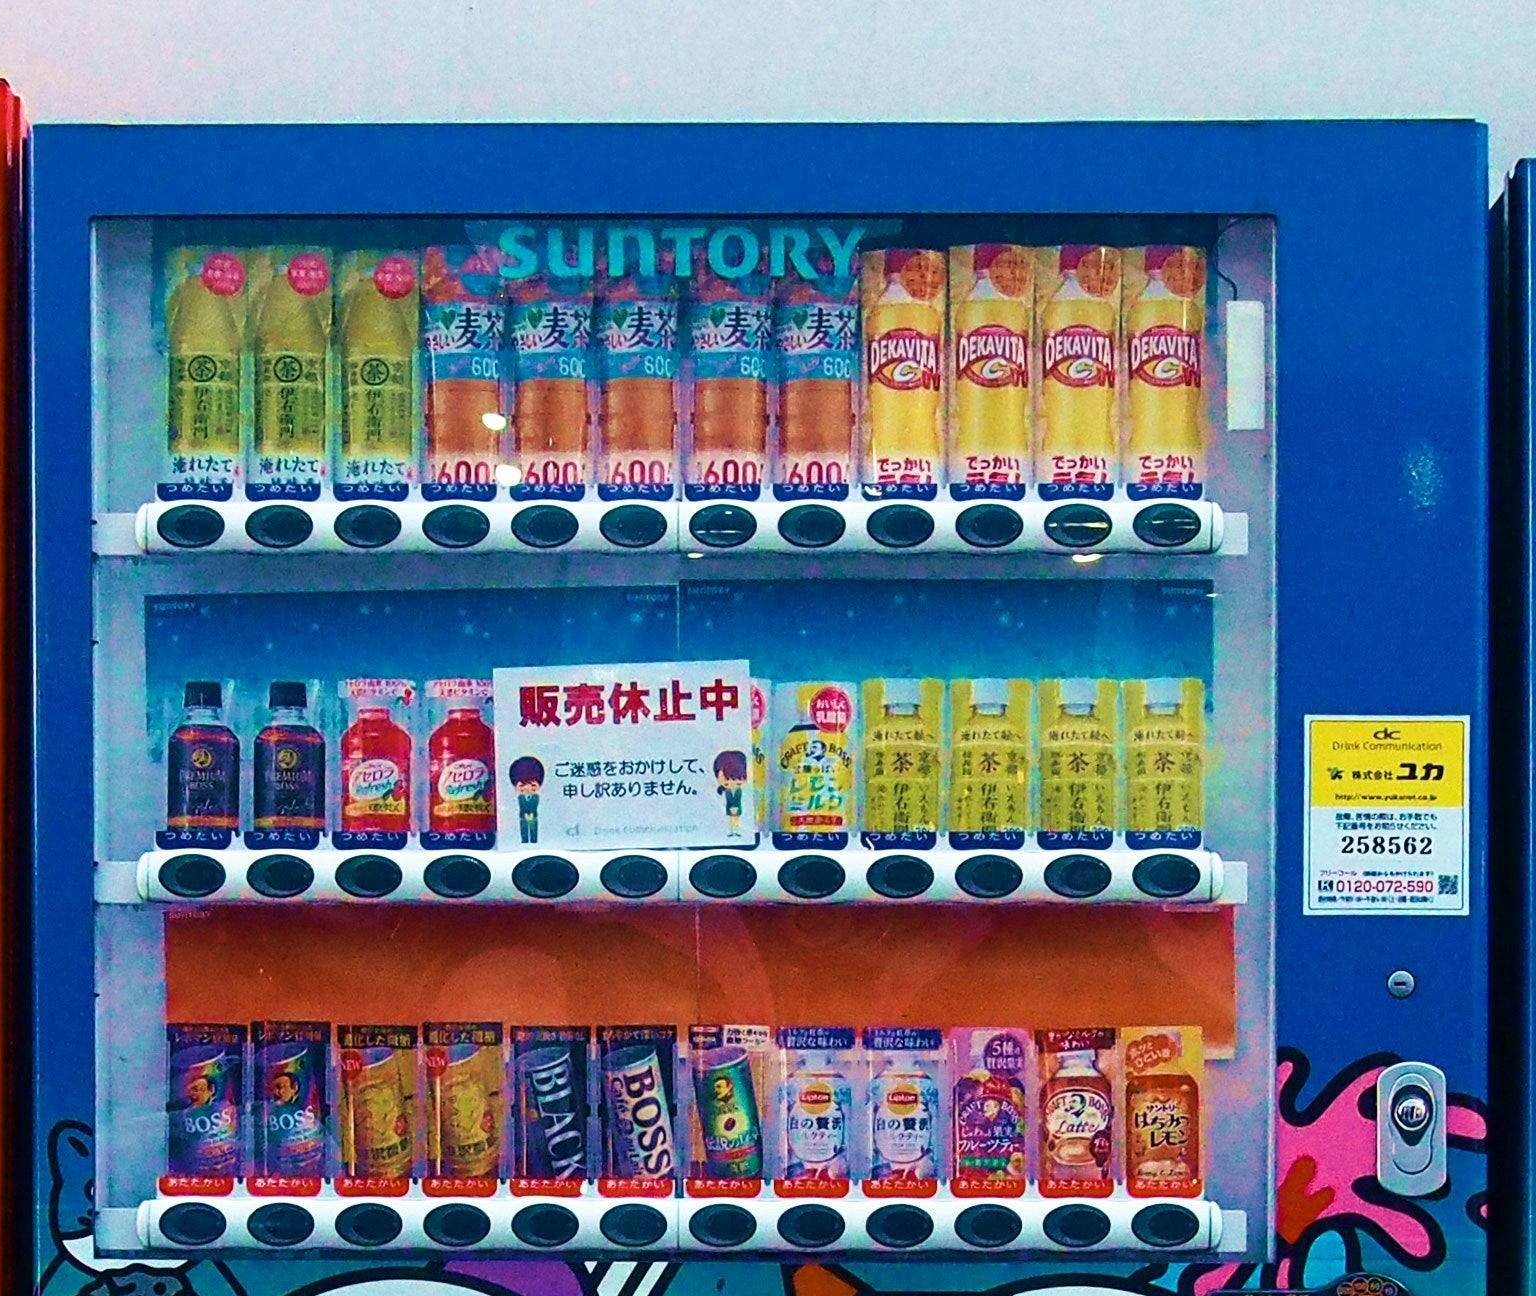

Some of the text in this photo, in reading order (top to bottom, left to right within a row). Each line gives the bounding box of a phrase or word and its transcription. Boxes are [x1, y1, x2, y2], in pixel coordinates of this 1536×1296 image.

[518, 676, 740, 727] 販売休止中
[1363, 740, 1442, 751] Communication
[1395, 763, 1445, 781] ユカ
[1340, 835, 1433, 855] 258562
[1336, 880, 1434, 894] 0120-072-590
[185, 1109, 232, 1134] BOSS
[268, 1106, 315, 1132] BOSS
[622, 1065, 673, 1177] BOSS
